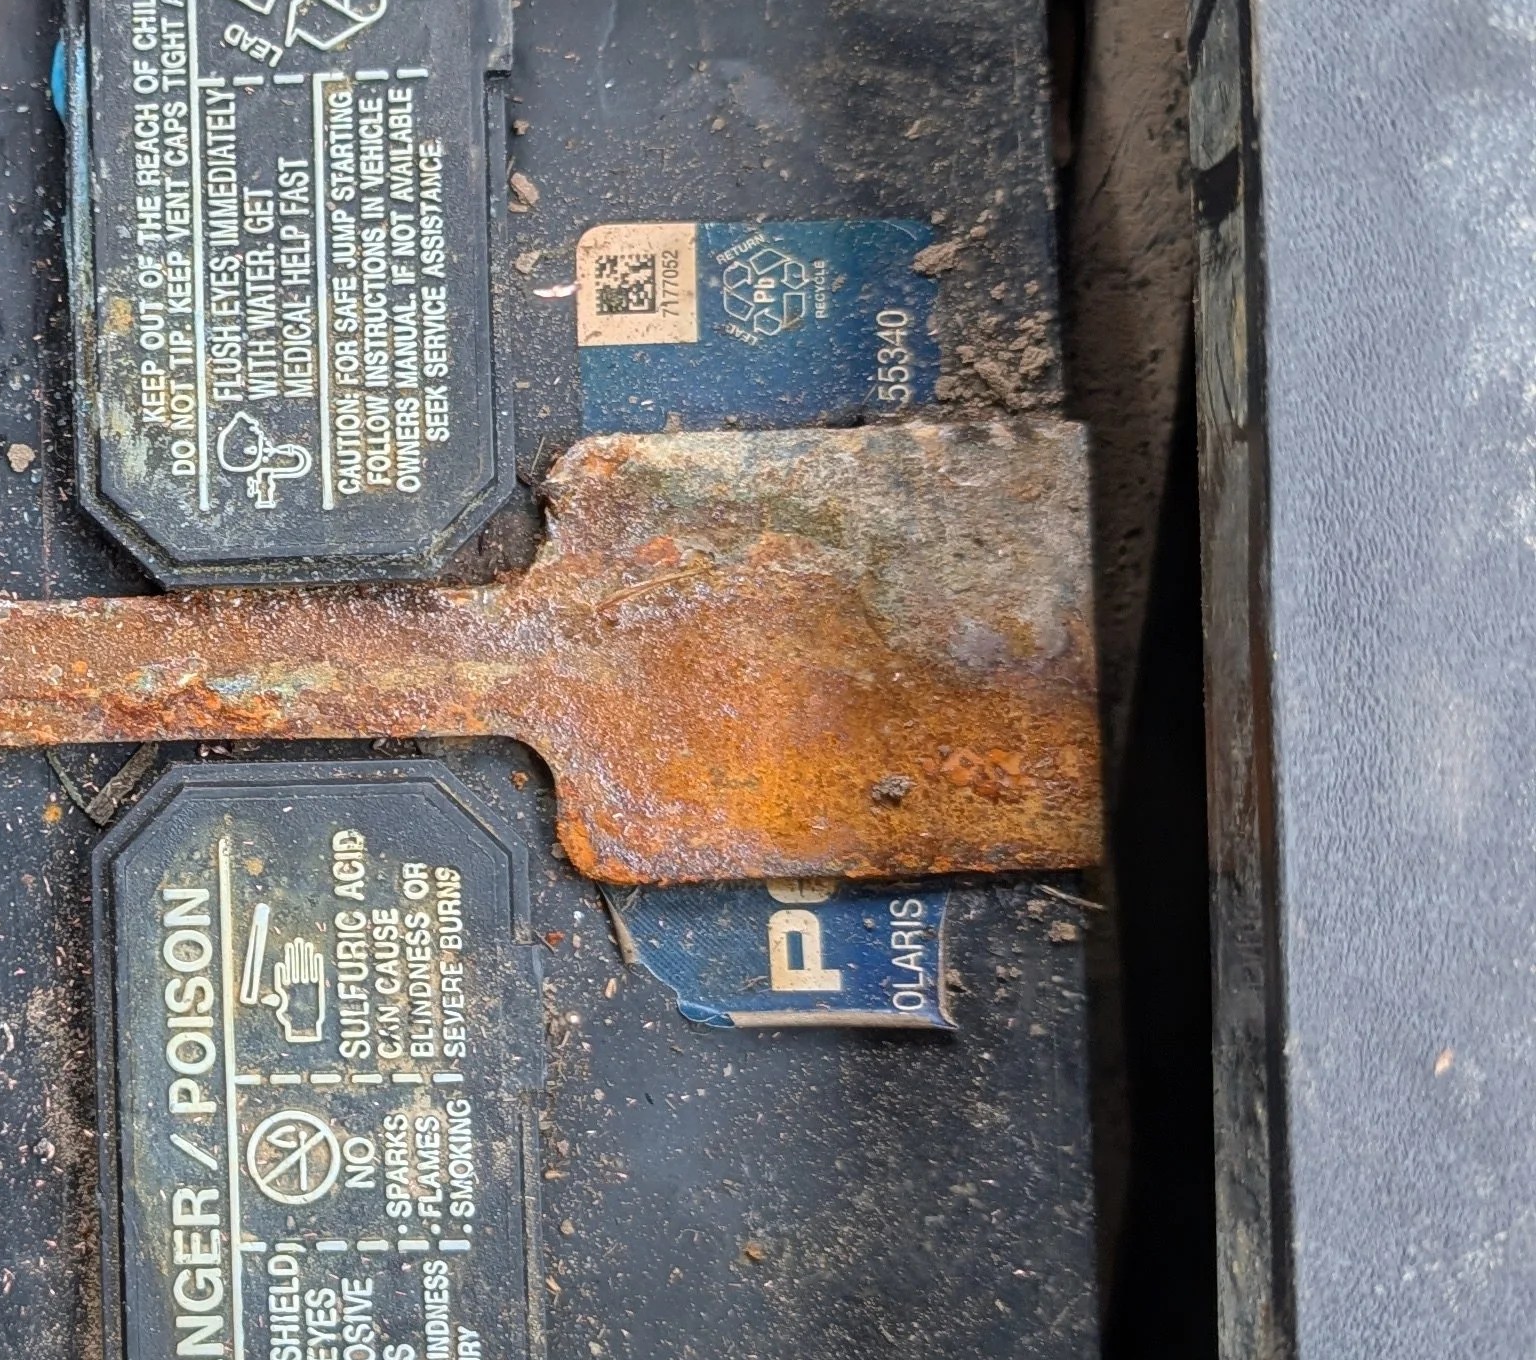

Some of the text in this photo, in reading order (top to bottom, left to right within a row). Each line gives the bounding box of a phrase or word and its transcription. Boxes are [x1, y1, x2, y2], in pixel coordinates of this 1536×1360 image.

[133, 60, 159, 93] OF
[161, 17, 186, 92] TIGHT
[224, 24, 284, 68] LEAD
[135, 103, 161, 186] REACH
[163, 101, 188, 166] CAPS
[136, 196, 164, 248] THE
[165, 177, 190, 241] VENT
[206, 89, 245, 401] FLUSH EYES IMMEDIATELY
[136, 254, 165, 288] OF
[166, 251, 192, 313] KEEP
[278, 157, 312, 397] MEDICAL HELP FAST
[662, 249, 679, 318] 7177052
[716, 233, 766, 265] RETURN
[139, 296, 164, 350] OUT
[243, 186, 280, 400] WITH WATER. GET
[328, 91, 362, 494] CAUTION: FOR SAFE JUMP STARTING
[359, 98, 392, 485] FOLLOW INSTRUCTIONS IN VEHICLE
[386, 88, 421, 492] OWNERS MANUAL. IF NOT AVAILABLE
[754, 277, 776, 303] Pb
[814, 259, 826, 320] RECYCLE
[169, 324, 193, 370] TIP.
[421, 286, 448, 377] SERVICE
[876, 310, 911, 403] 55340
[141, 360, 170, 422] KEEP
[170, 380, 196, 430] NOT
[425, 386, 450, 441] SEEK
[171, 438, 196, 475] DO
[335, 910, 371, 1059] SULFURIC
[372, 908, 402, 1058] CAN CAUSE
[403, 863, 433, 1057] BLINDNESS OR
[432, 867, 466, 1057] SEVERE BURNS
[889, 898, 925, 1015] OLARIS
[163, 889, 216, 1113] POISON
[343, 1136, 380, 1188] NO
[384, 1114, 410, 1217] SPARKS
[414, 1117, 442, 1217] FLAMES
[444, 1100, 474, 1217] SMOKING
